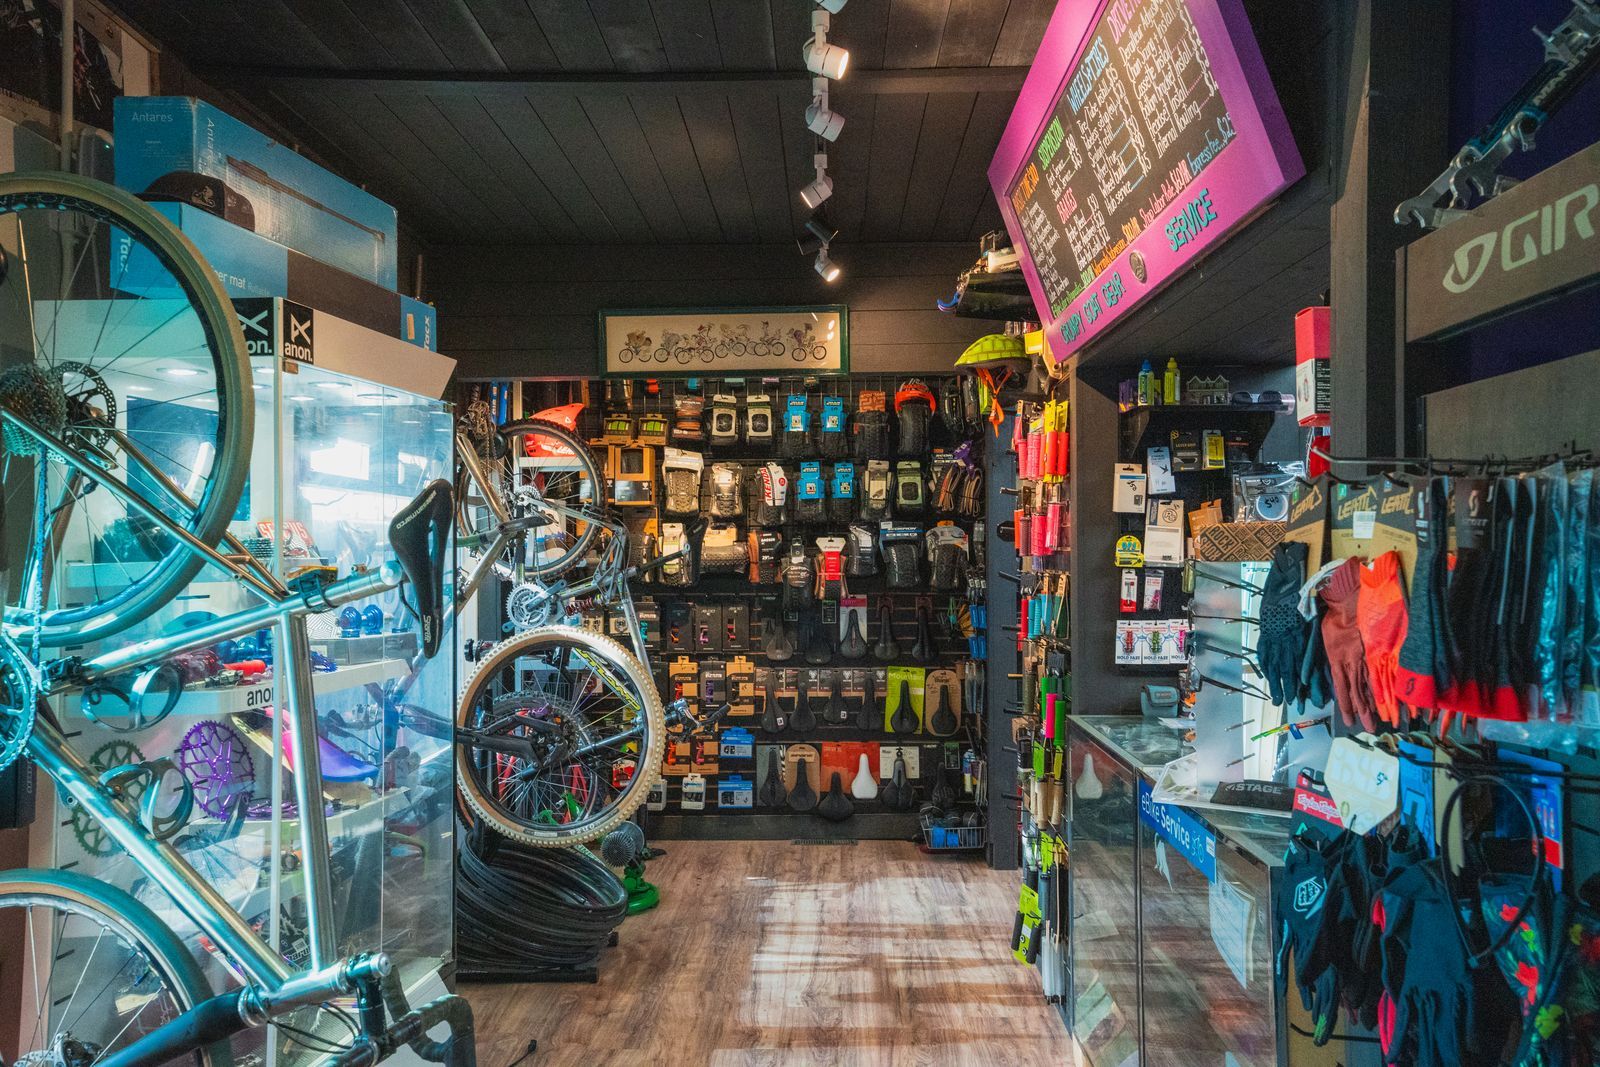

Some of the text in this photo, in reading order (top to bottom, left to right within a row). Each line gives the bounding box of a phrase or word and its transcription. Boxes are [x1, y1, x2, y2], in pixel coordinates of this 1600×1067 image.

[131, 112, 173, 122] Antares
[1165, 190, 1216, 250] SERVICE
[120, 237, 132, 273] Tacx
[229, 274, 247, 289] mat
[1060, 313, 1081, 342] GRUMPY
[1083, 293, 1101, 322] GOAT
[1101, 272, 1124, 306] GEAR
[285, 341, 313, 362] anon.
[760, 467, 773, 499] KENDA
[1201, 536, 1222, 560] SHOX
[1208, 525, 1236, 553] ROCK
[247, 687, 274, 706] ano
[1160, 805, 1190, 849] Service
